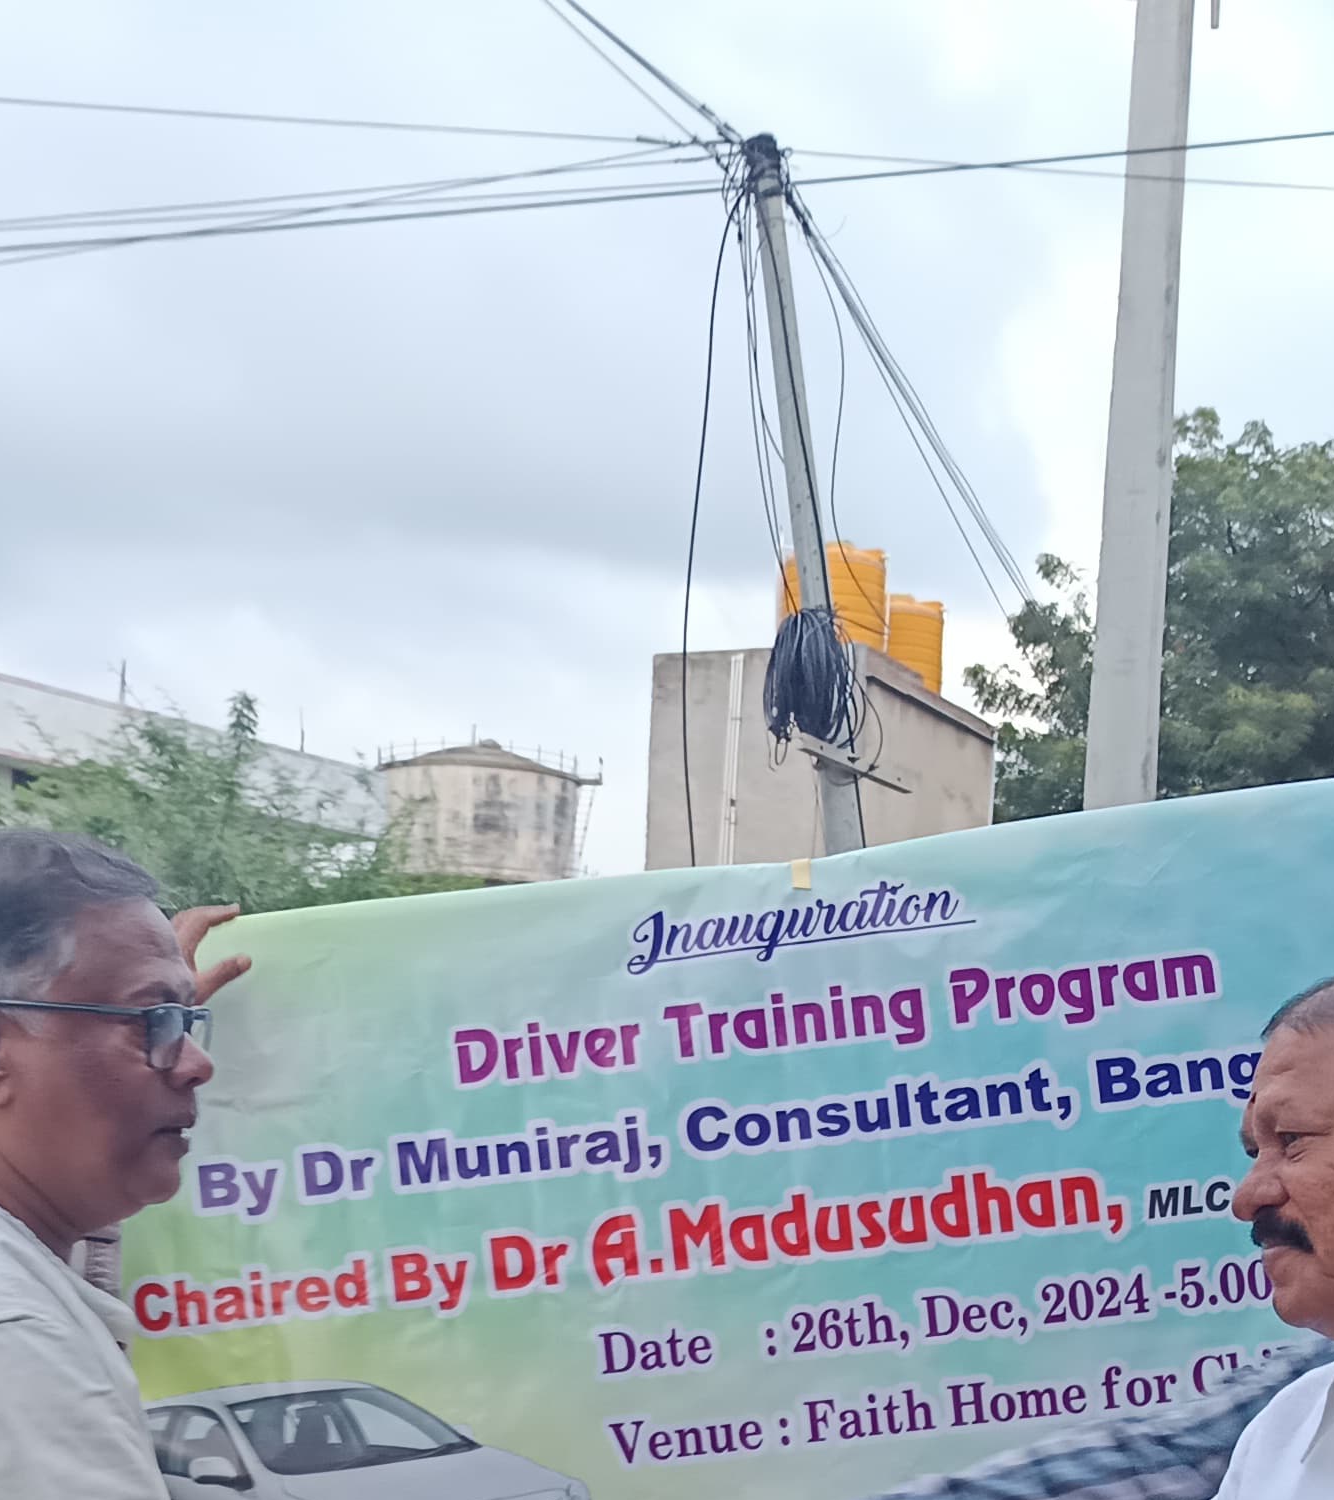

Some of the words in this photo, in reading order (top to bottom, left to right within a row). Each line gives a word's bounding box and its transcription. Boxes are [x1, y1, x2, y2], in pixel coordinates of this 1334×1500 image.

[627, 880, 975, 975] Inauguration
[454, 1021, 640, 1084] Driver
[663, 984, 926, 1058] Training
[949, 954, 1216, 1024] Program
[198, 1161, 278, 1217] By
[302, 1149, 375, 1197] Dr
[396, 1114, 662, 1187] Muniraj,
[685, 1067, 1072, 1152] Consultant,
[134, 1258, 370, 1333] Chaired
[391, 1252, 468, 1311] By
[490, 1234, 569, 1292] Dr
[591, 1171, 1124, 1288] A.Madusudhan,
[1148, 1181, 1230, 1219] MLC
[599, 1328, 713, 1375] Date
[791, 1301, 911, 1353] 26th,
[922, 1294, 1029, 1338] Dec,
[1041, 1272, 1150, 1325] 2024
[609, 1419, 764, 1464] Venue
[803, 1389, 936, 1443] Faith
[947, 1380, 1087, 1427] Home
[1101, 1365, 1178, 1410] for
